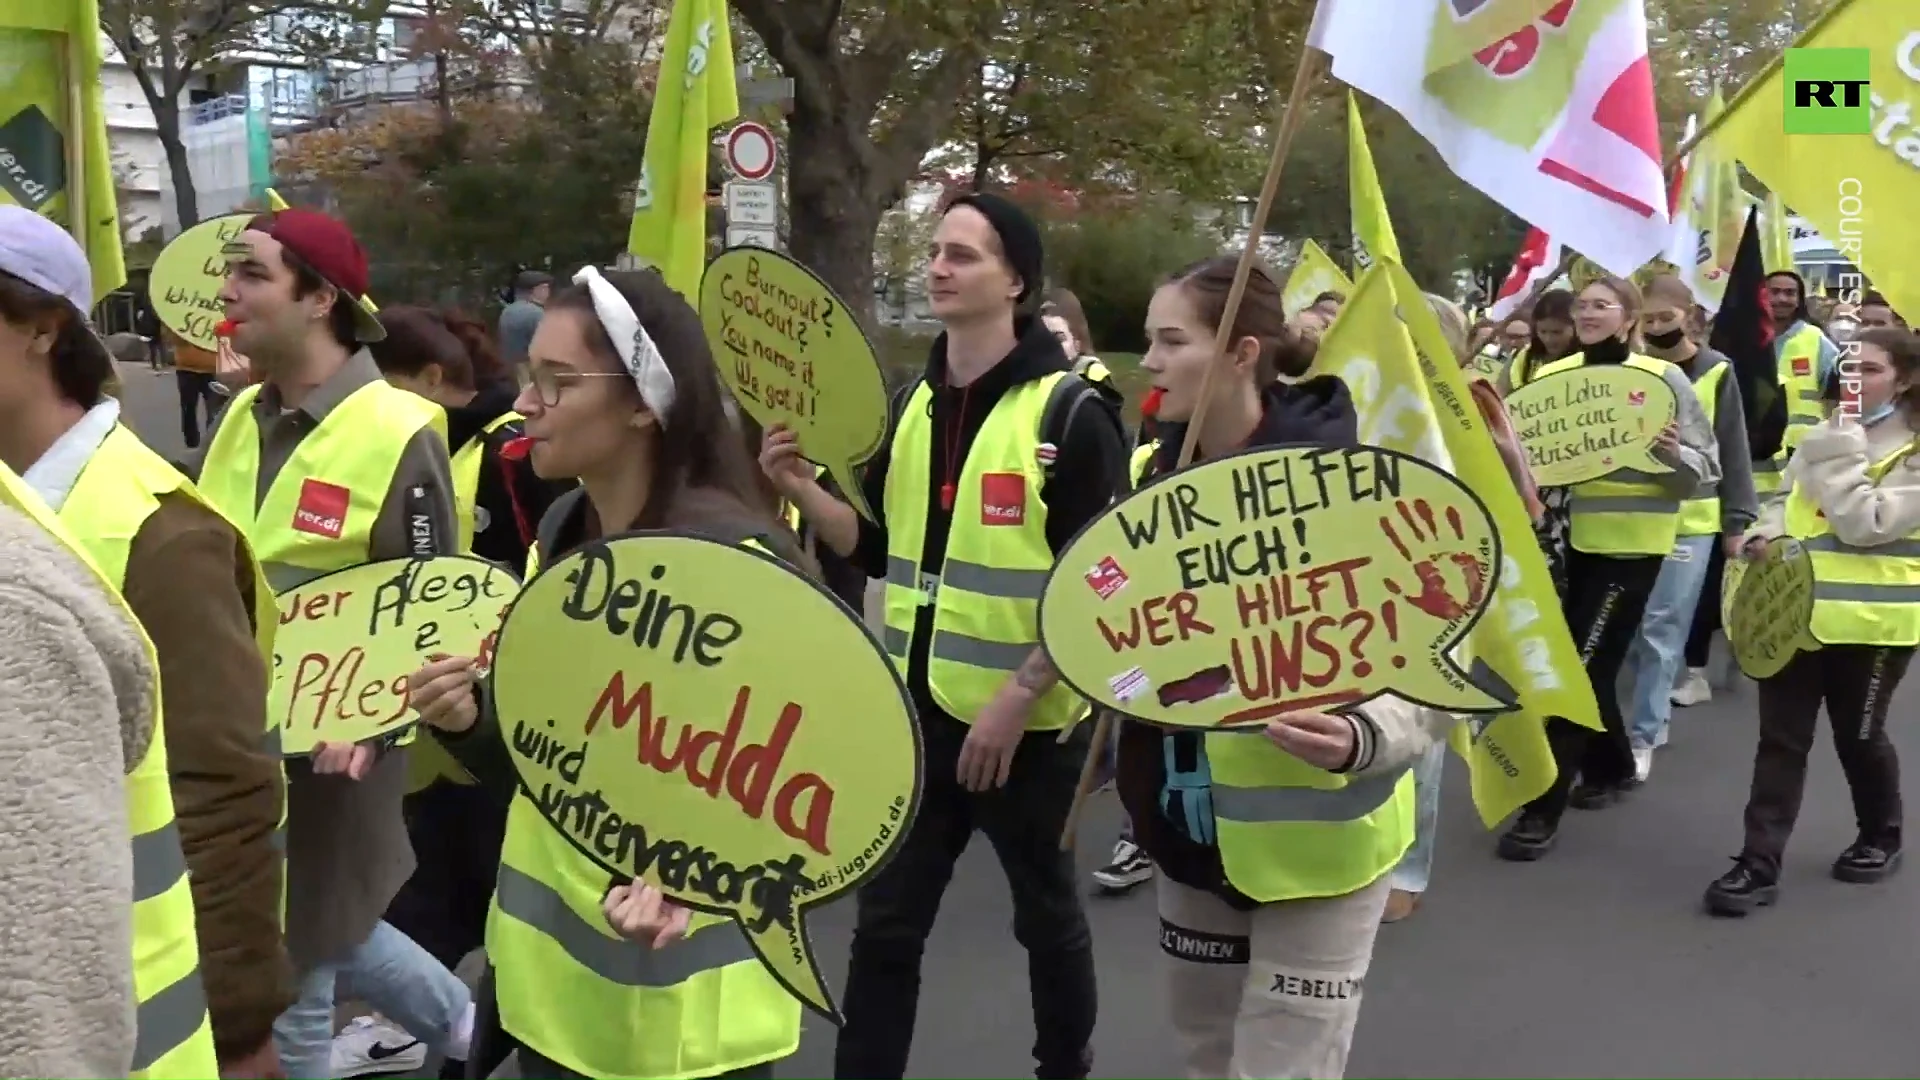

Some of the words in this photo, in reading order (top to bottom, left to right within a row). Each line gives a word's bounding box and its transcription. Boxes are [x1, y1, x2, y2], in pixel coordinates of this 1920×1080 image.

[745, 256, 834, 338] Burnout?
[720, 309, 748, 354] You
[753, 339, 796, 377] name
[734, 357, 759, 395] We
[765, 384, 792, 410] got
[1509, 395, 1557, 419] Mein
[1566, 378, 1613, 407] Lohn
[1548, 416, 1568, 434] in
[1576, 407, 1620, 427] eine
[297, 510, 340, 533] ver.di
[983, 503, 1021, 517] ver.di
[1117, 484, 1219, 550] WIR
[1232, 449, 1401, 522] HELFEN
[1176, 517, 1312, 591] EUCH!
[563, 544, 742, 666] Deine
[1097, 590, 1214, 653] WER
[1236, 556, 1372, 629] HILFT
[286, 646, 411, 729] Pfleg
[1231, 600, 1407, 702] UNS?!
[513, 719, 588, 785] wird
[585, 671, 835, 856] Mudda
[540, 783, 818, 934] unterversorgt
